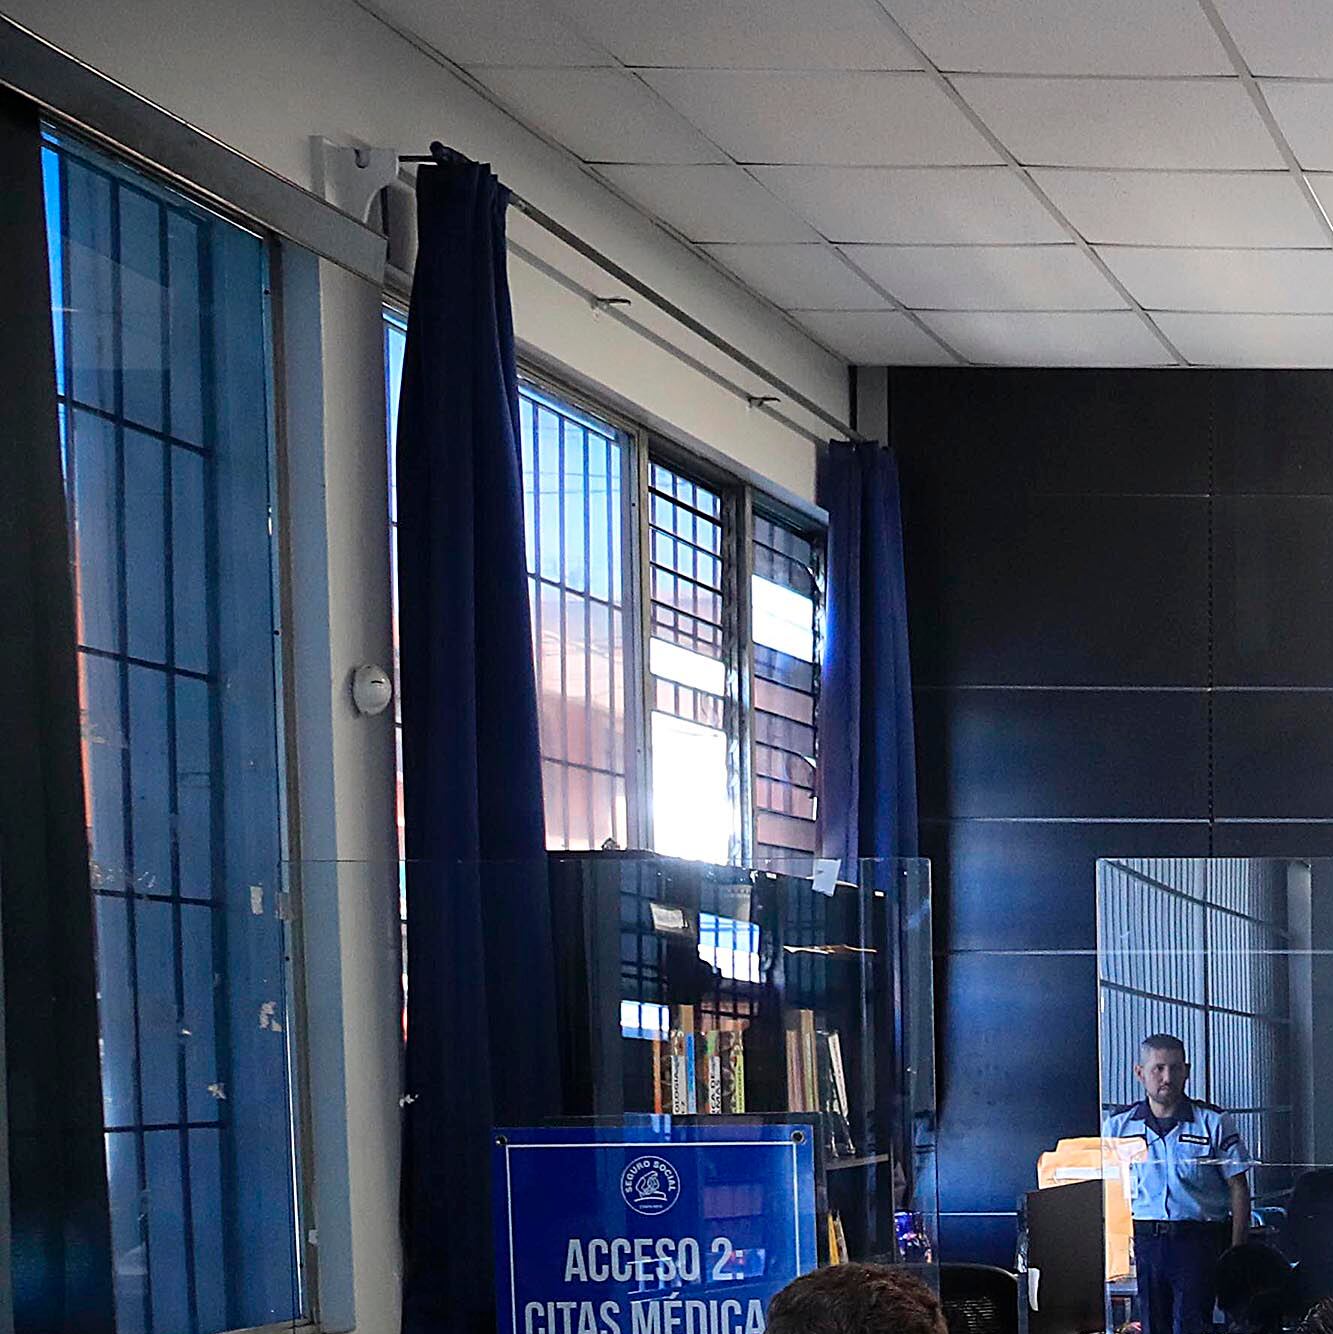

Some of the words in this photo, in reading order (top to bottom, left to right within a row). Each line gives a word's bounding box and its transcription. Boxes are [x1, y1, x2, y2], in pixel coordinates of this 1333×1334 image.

[625, 1160, 651, 1193] SEGURO
[653, 1160, 676, 1192] SOCIAL
[564, 1237, 700, 1283] ACCESO
[711, 1236, 745, 1281] 2:
